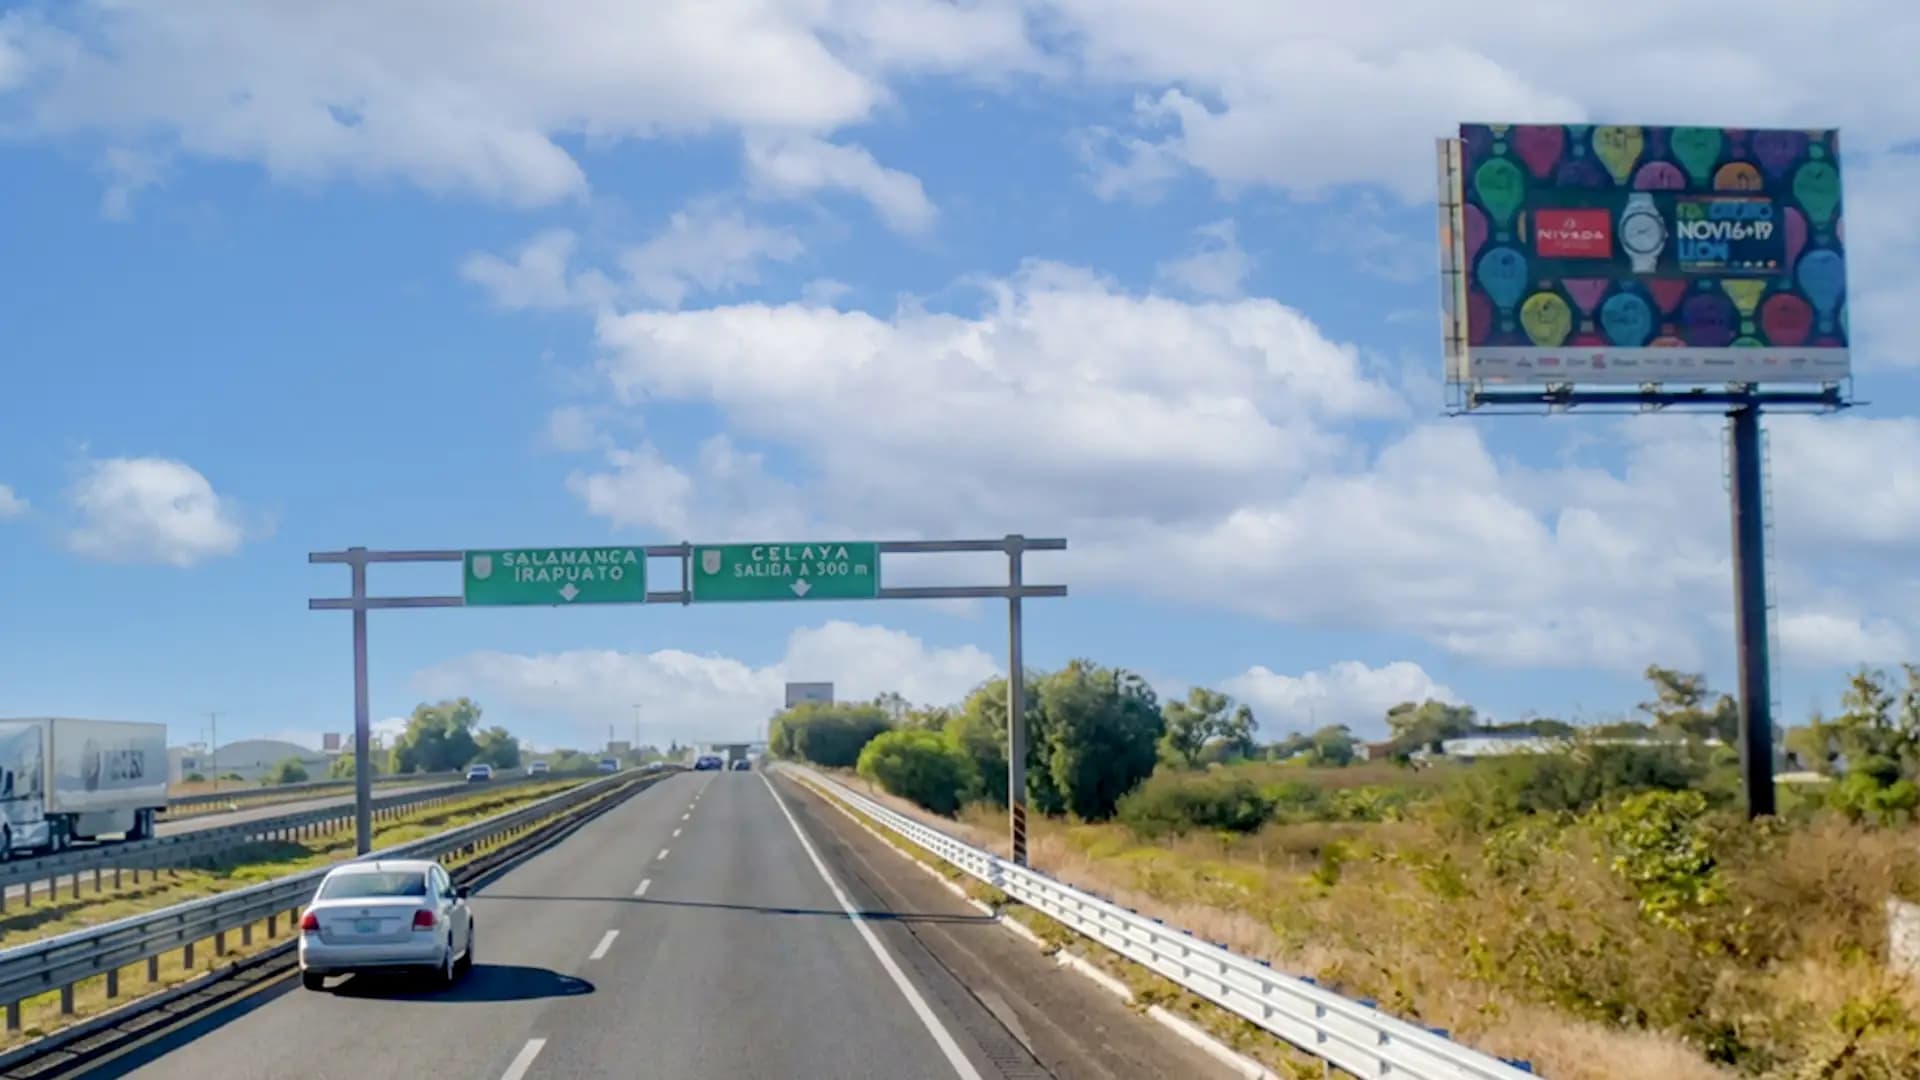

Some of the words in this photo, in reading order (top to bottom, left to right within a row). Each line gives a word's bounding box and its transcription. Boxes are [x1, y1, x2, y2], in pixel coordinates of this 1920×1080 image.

[502, 549, 637, 566] SALAMANCA
[751, 545, 849, 561] CELAYA
[514, 565, 624, 582] IRAPUATO
[734, 562, 792, 577] SALIDA
[799, 562, 810, 577] A
[854, 563, 868, 576] m
